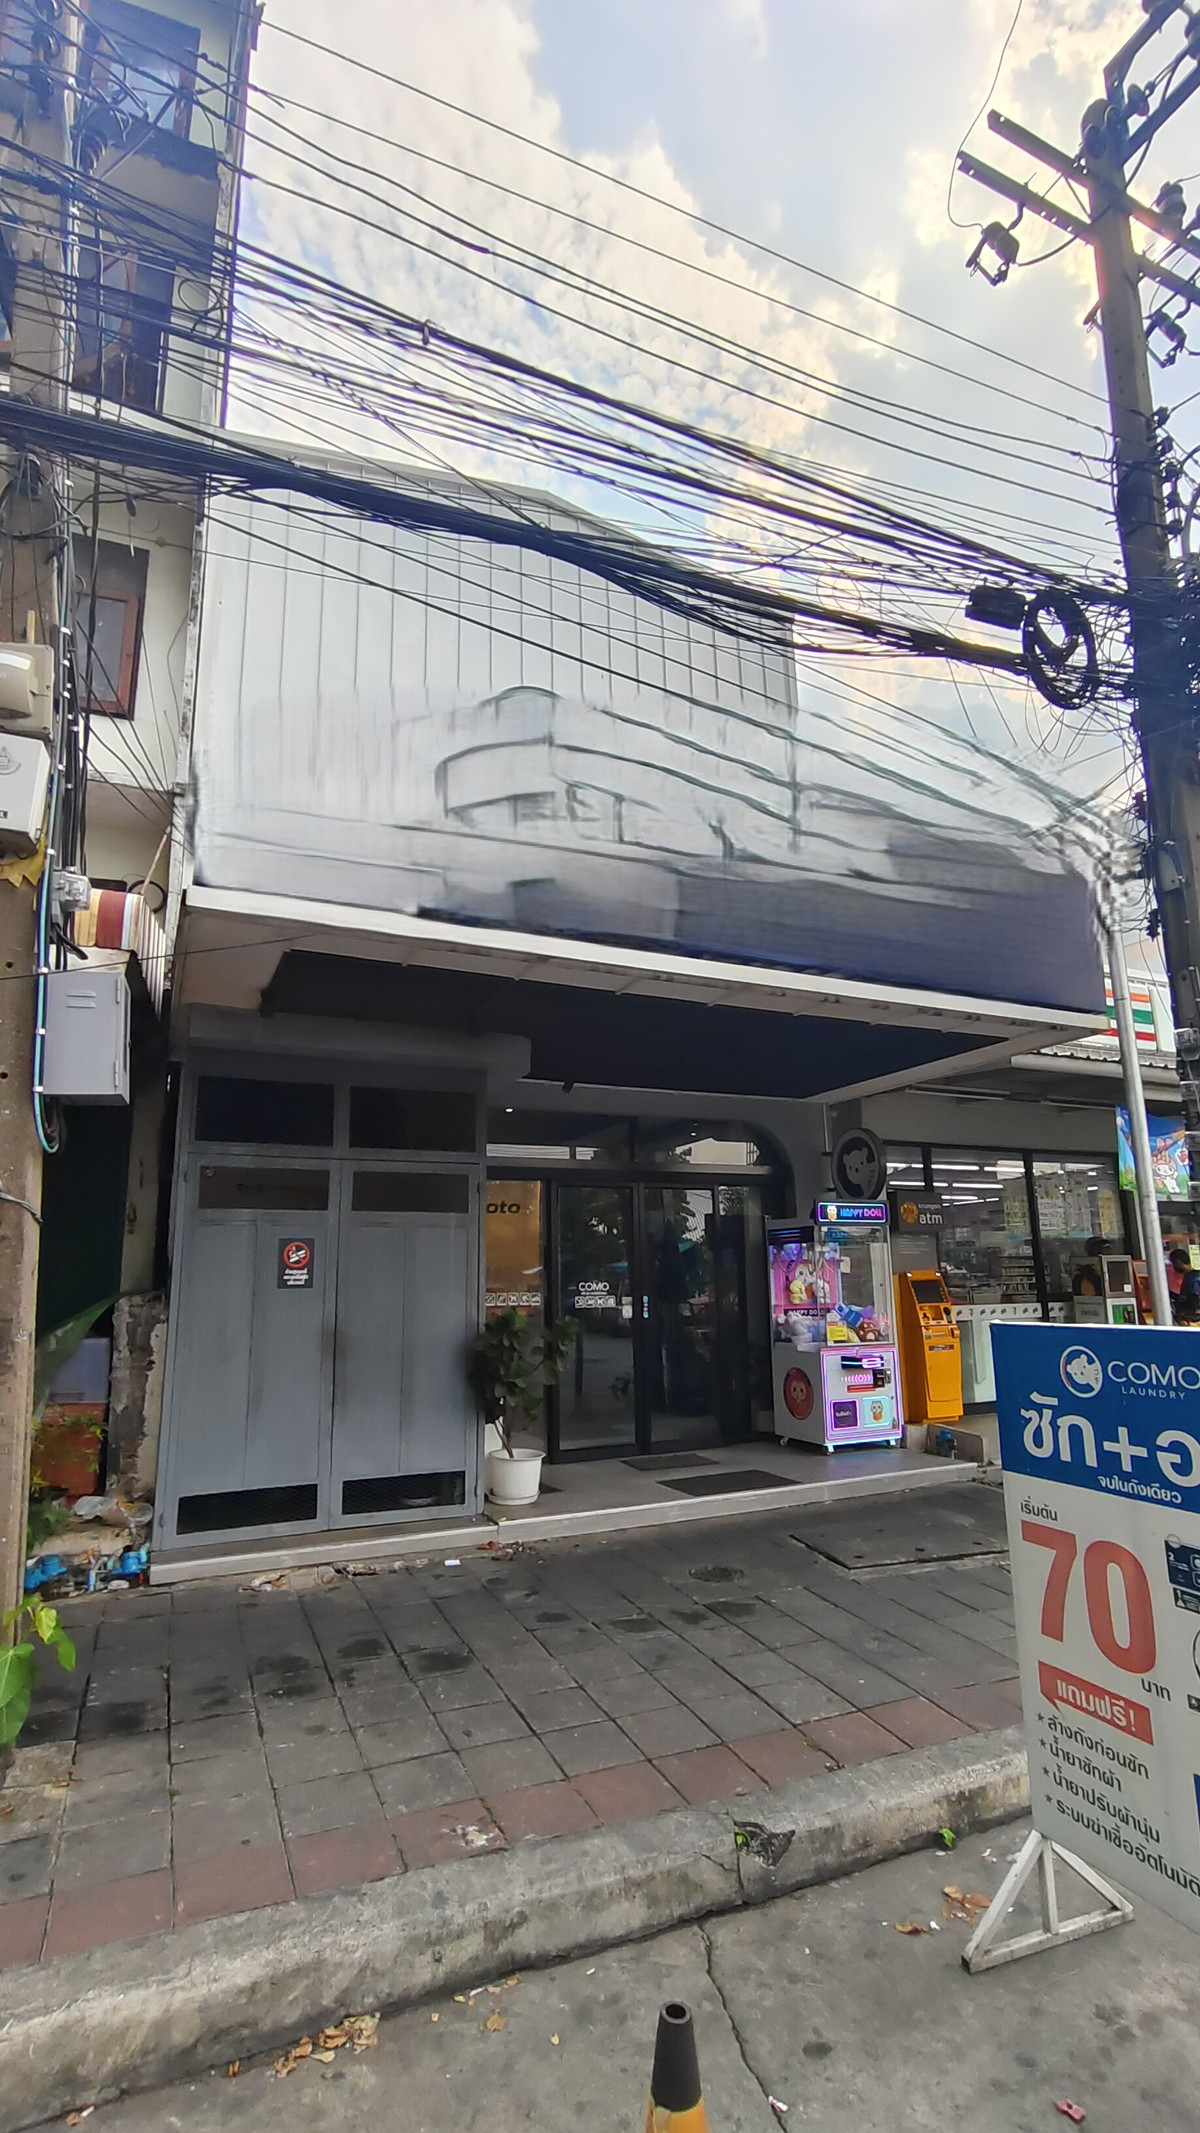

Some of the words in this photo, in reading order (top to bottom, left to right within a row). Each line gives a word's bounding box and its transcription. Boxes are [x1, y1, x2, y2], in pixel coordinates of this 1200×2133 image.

[919, 1212, 943, 1225] atm
[579, 1282, 610, 1292] COMO
[1107, 1361, 1200, 1390] COMO
[1121, 1386, 1186, 1400] LAUNDRY
[1097, 1475, 1182, 1504] จบในถังเดียว
[1020, 1495, 1058, 1521] เริ่มต้น
[1021, 1519, 1157, 1674] 70
[1140, 1677, 1171, 1702] บาท
[1056, 1678, 1136, 1732] แถมฟรี!
[1050, 1734, 1122, 1793] น้ำยาซักผ้า
[1052, 1763, 1161, 1844] น้ำยาปรับผ้านุ่ม
